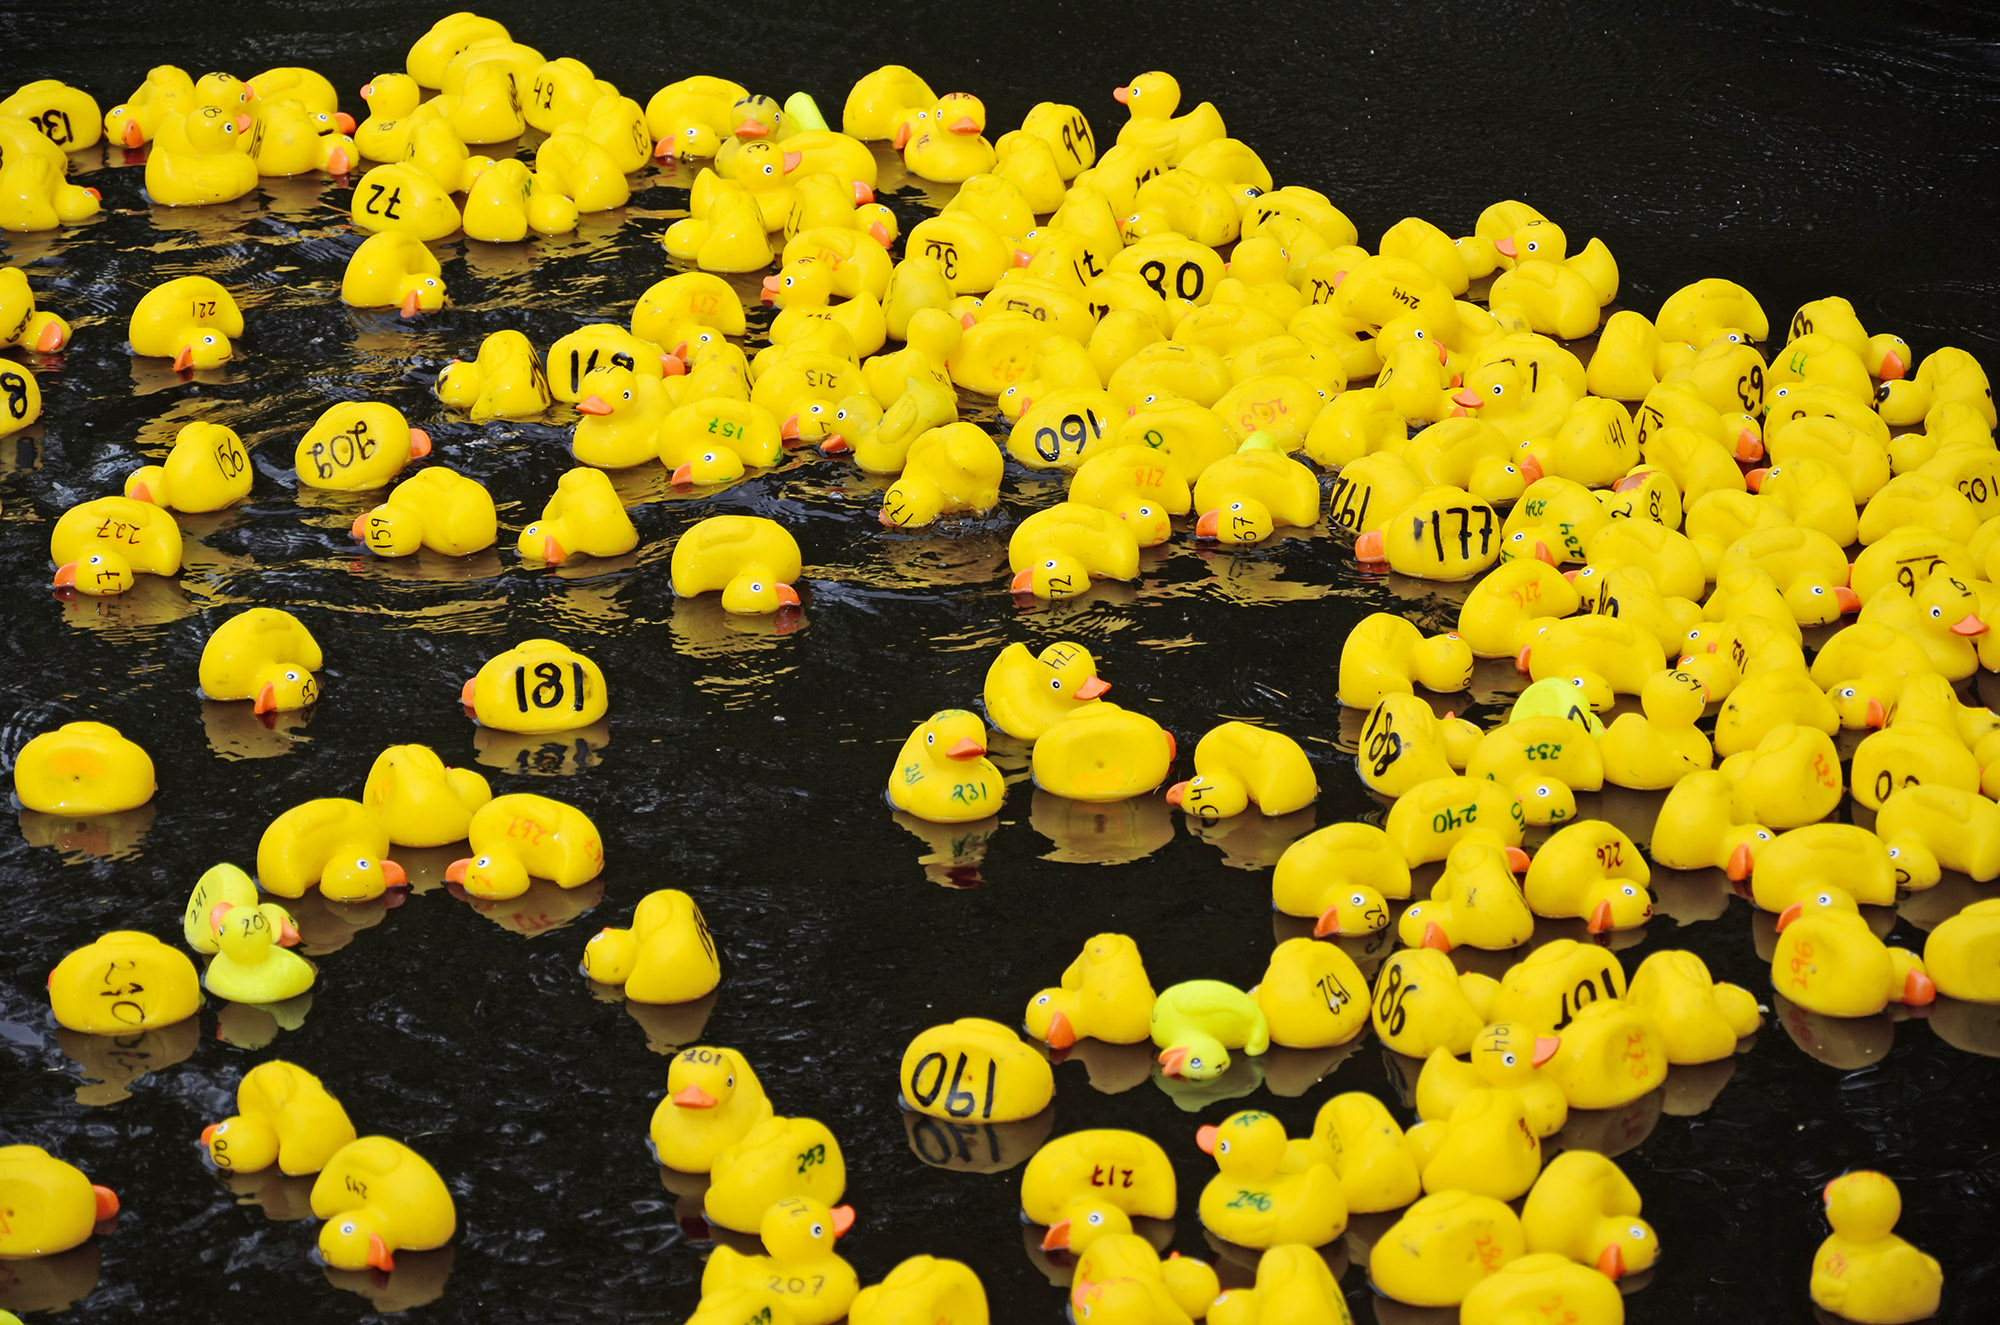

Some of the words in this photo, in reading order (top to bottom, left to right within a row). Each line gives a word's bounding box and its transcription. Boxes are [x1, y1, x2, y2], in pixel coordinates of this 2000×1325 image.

[1062, 115, 1093, 165] 94
[367, 184, 401, 220] 72
[192, 301, 216, 318] 221
[1393, 286, 1420, 310] 244
[805, 369, 838, 388] 213
[708, 417, 743, 440] 157
[1035, 408, 1101, 462] 160
[213, 437, 243, 481] 156
[97, 518, 141, 546] 227
[370, 518, 391, 548] 159
[1433, 505, 1492, 561] 177
[1559, 523, 1585, 558] 234
[1042, 642, 1081, 670] 174
[515, 662, 585, 713] 181
[1524, 744, 1562, 760] 237
[951, 782, 988, 806] 231
[506, 817, 547, 846] 267
[1433, 804, 1477, 833] 240
[1596, 842, 1624, 870] 226
[190, 886, 206, 924] 241
[911, 1051, 996, 1119] 190
[1091, 1164, 1133, 1187] 217
[768, 1275, 825, 1297] 207
